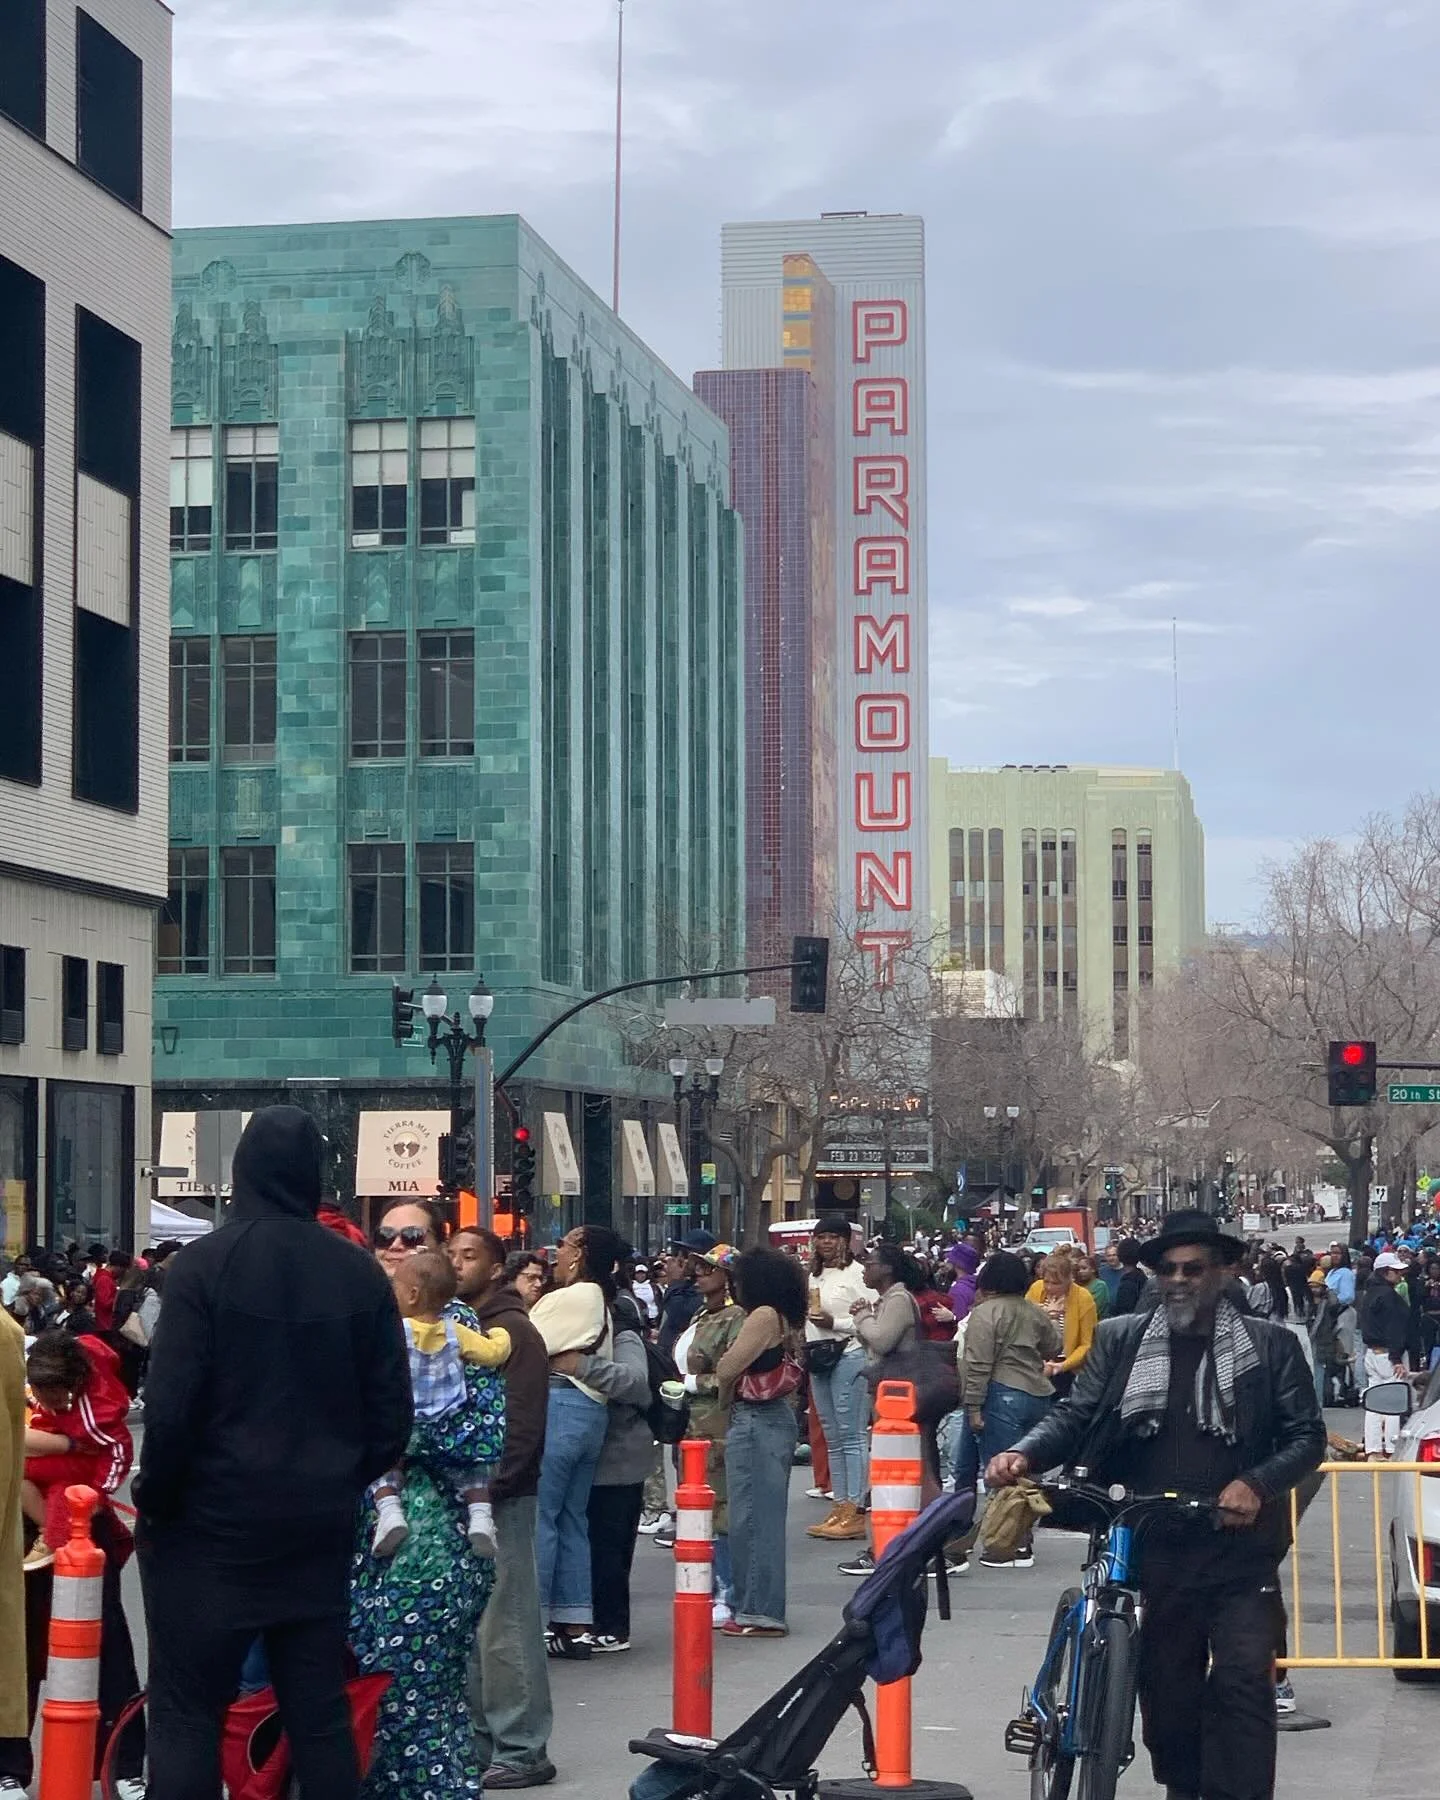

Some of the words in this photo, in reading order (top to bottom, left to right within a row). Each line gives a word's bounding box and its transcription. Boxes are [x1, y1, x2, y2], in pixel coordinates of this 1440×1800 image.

[852, 300, 912, 990] PARAMOUNT
[383, 1119, 414, 1139] TIERRA
[415, 1123, 431, 1139] MIA
[830, 1150, 845, 1162] FEB
[848, 1150, 859, 1162] 23
[387, 1158, 423, 1170] COFFEE
[388, 1180, 420, 1192] MIA
